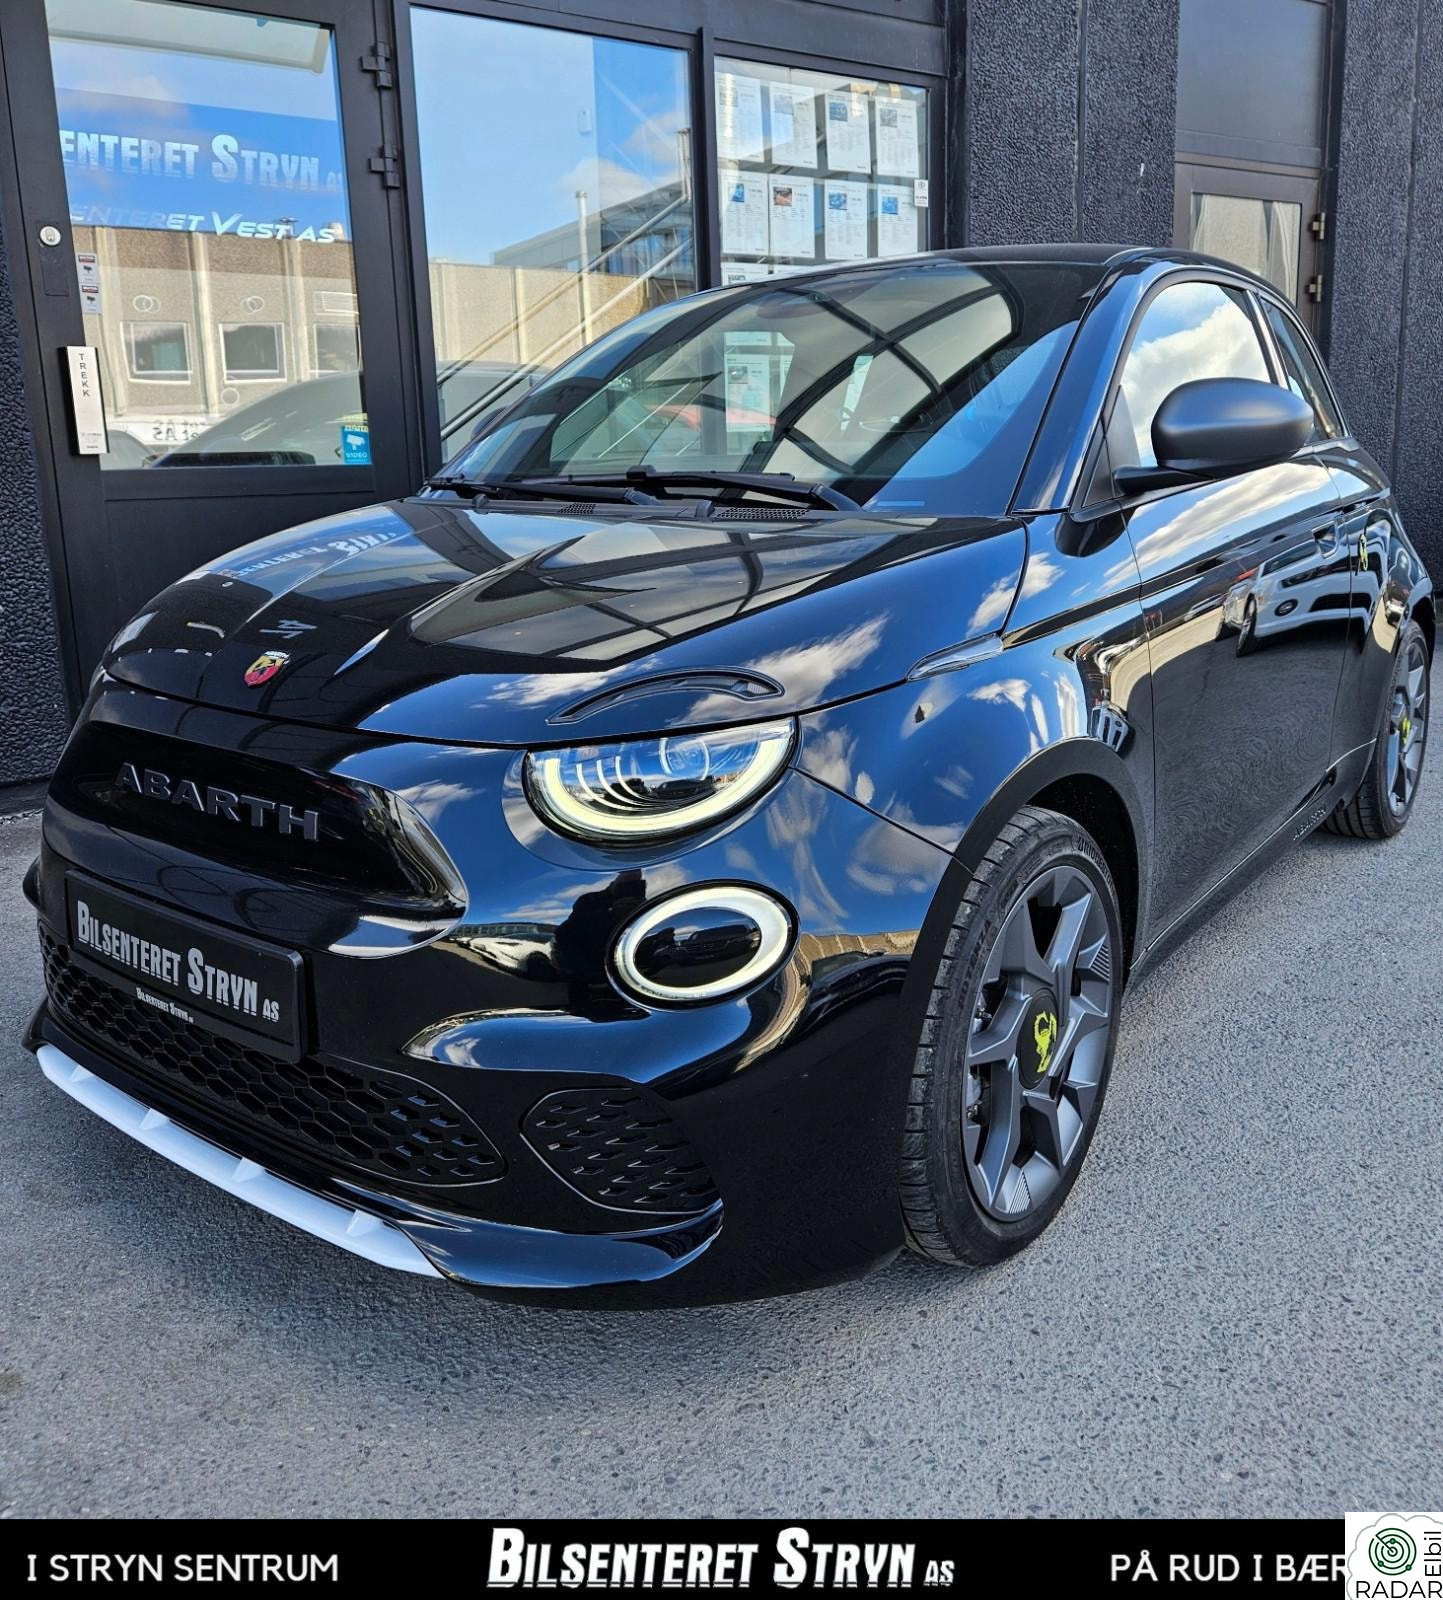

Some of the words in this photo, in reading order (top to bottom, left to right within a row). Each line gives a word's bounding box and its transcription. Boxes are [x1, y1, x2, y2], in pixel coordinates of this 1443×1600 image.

[212, 134, 319, 192] STRYN
[211, 211, 292, 240] VEST
[296, 225, 338, 243] AS
[78, 352, 90, 397] TREKK
[115, 762, 320, 841] ABARTH
[77, 899, 182, 987] BILSENTERET
[187, 947, 259, 1017] STRYN
[262, 998, 280, 1023] AS
